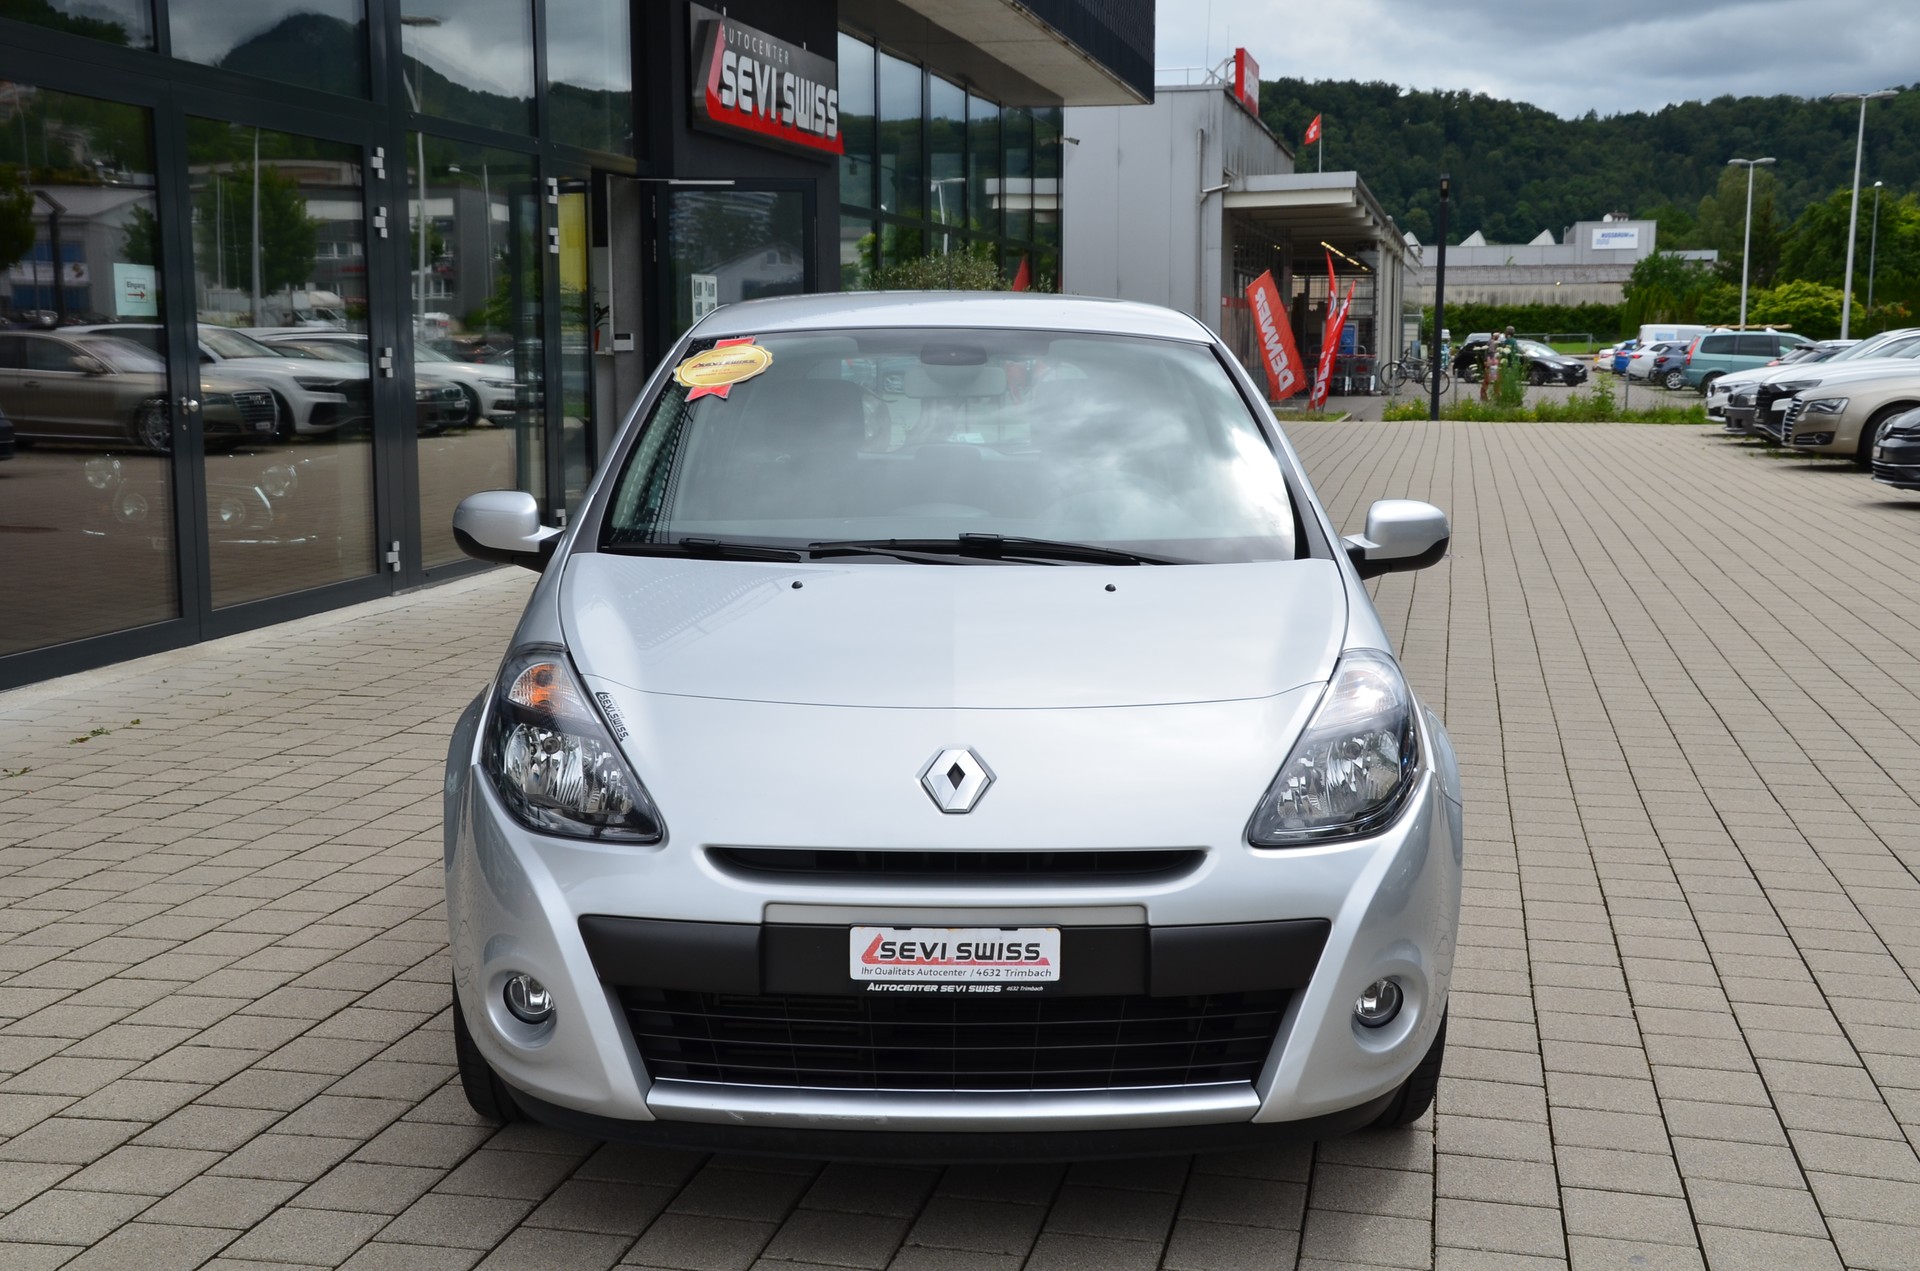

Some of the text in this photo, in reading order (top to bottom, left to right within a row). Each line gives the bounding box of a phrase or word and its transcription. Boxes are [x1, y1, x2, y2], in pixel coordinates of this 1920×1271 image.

[722, 25, 789, 65] AUTOCENTER
[721, 50, 838, 139] SEVI SWISS
[126, 281, 146, 290] Eingang
[599, 694, 616, 713] SEVI
[610, 712, 629, 738] SWISS
[878, 942, 1041, 961] SEVI SWISS
[861, 967, 873, 975] Ihr
[917, 968, 967, 977] Autocenter
[976, 969, 1001, 977] 4632
[1005, 969, 1052, 977] Trimbach
[940, 985, 966, 993] SEVI
[968, 985, 1002, 993] SWISS
